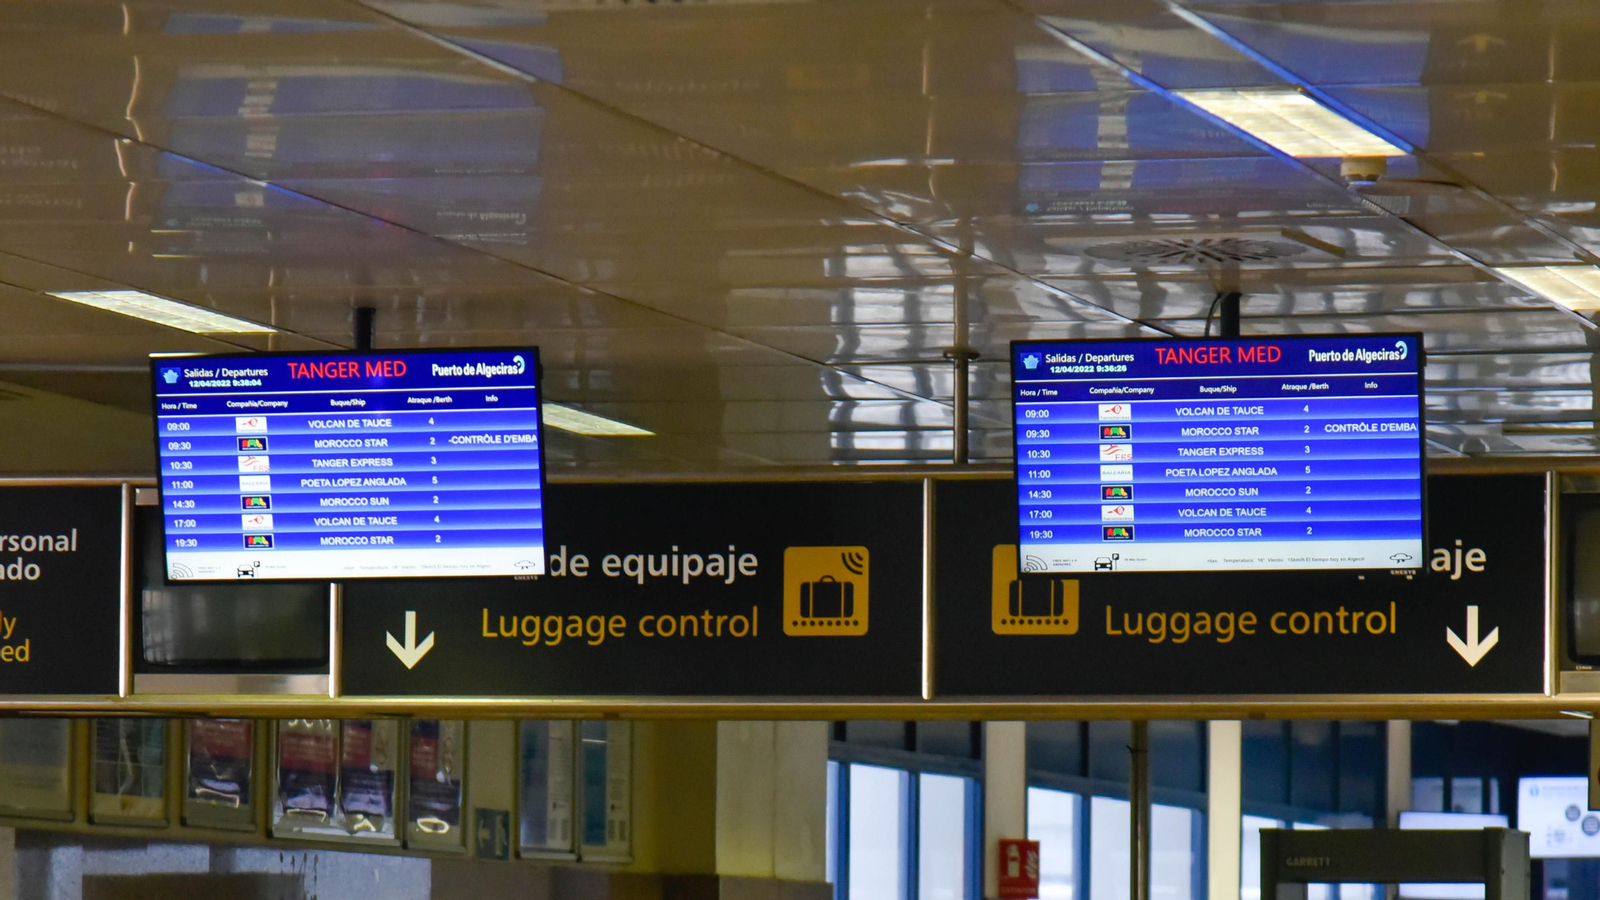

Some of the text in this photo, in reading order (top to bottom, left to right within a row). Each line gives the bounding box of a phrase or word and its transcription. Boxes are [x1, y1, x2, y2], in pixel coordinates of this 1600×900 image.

[1046, 354, 1076, 364] Salidas
[1086, 352, 1134, 364] Departures
[1155, 346, 1281, 364] TANGER MED
[1309, 348, 1399, 363] Puerto de Algeciras
[184, 368, 214, 378] Salidas
[222, 368, 268, 380] Departures
[288, 360, 406, 379] TANGER MED
[432, 362, 518, 378] Puerto de Algeciras
[1050, 364, 1126, 374] 12/04/2022 9:36:26
[190, 378, 262, 388] 12/04/2022 9:38:04
[1282, 384, 1308, 392] Atraque
[1200, 384, 1238, 394] Buque/Ship
[330, 398, 366, 408] Buque/Ship
[408, 396, 432, 404] Atraque
[182, 402, 198, 410] Time
[1176, 406, 1264, 416] VOLCAN DE TAUCE
[1304, 404, 1310, 412] 4
[1026, 410, 1050, 418] 09:00
[308, 418, 392, 428] VOLCAN DE TAUCE
[428, 416, 434, 424] 4
[166, 422, 190, 430] 09:00
[1182, 426, 1258, 436] MOROCCO STAR
[1304, 424, 1310, 434] 2
[1380, 422, 1416, 432] D'EMBA
[504, 434, 538, 444] D'EMBA
[1026, 430, 1050, 438] 09:30
[314, 438, 388, 448] MOROCCO STAR
[430, 436, 436, 444] 2
[168, 442, 192, 450] 09:30
[1178, 446, 1264, 456] TANGER EXPRESS
[1304, 446, 1310, 454] 3
[1028, 450, 1050, 458] 10:30
[170, 460, 192, 470] 10:30
[312, 458, 394, 468] TANGER EXPRESS
[430, 456, 436, 464] 3
[1028, 470, 1050, 478] 11:00
[1166, 466, 1278, 478] POETA LOPEZ ANGLADA
[1304, 466, 1310, 474] 5
[172, 480, 194, 488] 11:00
[300, 476, 406, 488] POETA LOPEZ ANGLADA
[432, 476, 438, 484] 5
[1028, 490, 1052, 498] 14:30
[1186, 488, 1258, 496] MOROCCO SUN
[1306, 486, 1312, 494] 2
[172, 500, 196, 508] 14:30
[320, 496, 390, 506] MOROCCO SUN
[432, 496, 438, 504] 2
[1030, 510, 1052, 518] 17:00
[1178, 508, 1266, 518] VOLCAN DE TAUCE
[174, 518, 196, 528] 17:00
[314, 516, 398, 526] VOLCAN DE TAUCE
[434, 516, 440, 524] 4
[1030, 530, 1052, 538] 19:30
[1184, 528, 1262, 538] MOROCCO STAR
[1306, 526, 1312, 534] 2
[174, 538, 198, 548] 19:30
[320, 536, 394, 546] MOROCCO STAR
[434, 534, 442, 542] 2
[550, 545, 757, 584] de equipaje
[482, 605, 758, 646] Luggage control
[1106, 601, 1396, 643] Luggage control
